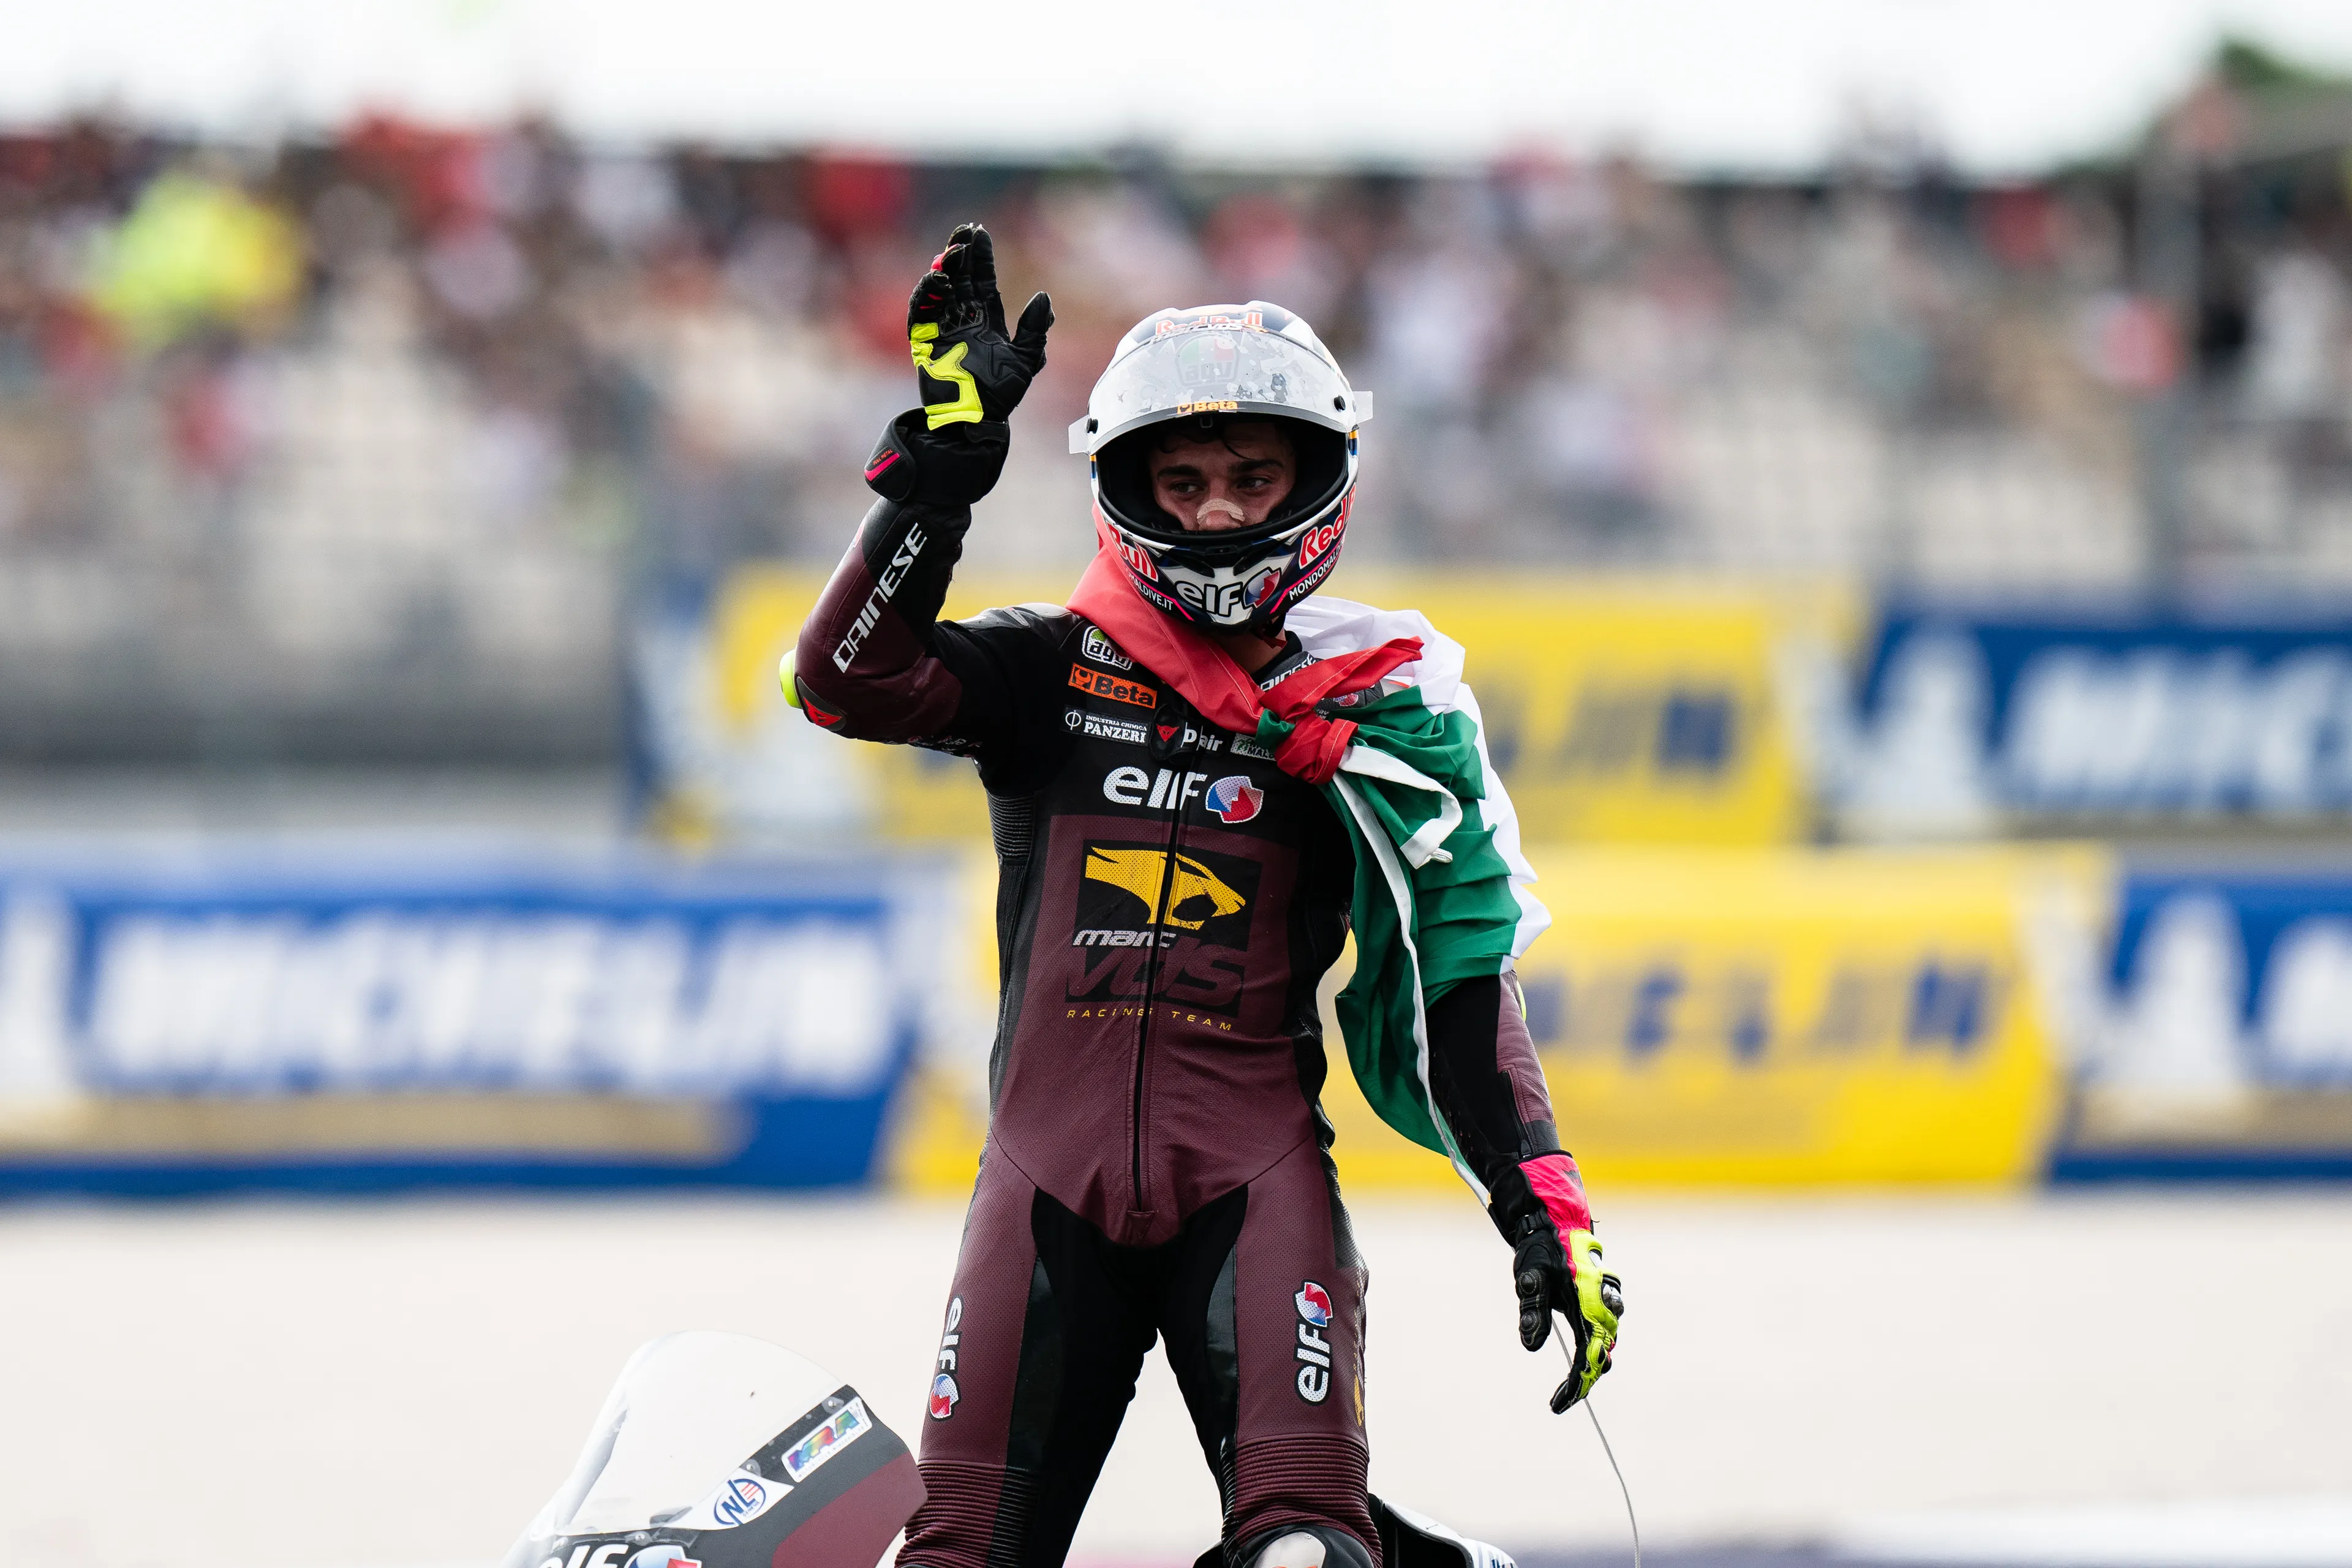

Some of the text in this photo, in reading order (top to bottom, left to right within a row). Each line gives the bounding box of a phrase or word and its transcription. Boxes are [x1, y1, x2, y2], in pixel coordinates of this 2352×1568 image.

[1194, 401, 1238, 413] Beta
[1298, 494, 1348, 570] Red
[1106, 522, 1159, 582] Bull
[832, 522, 927, 673] DAINESE
[1176, 582, 1242, 616] elf
[1093, 674, 1153, 706] Beta
[1083, 722, 1146, 743] PANZERI
[1086, 715, 1147, 731] INDUSTRIA CHIMICA
[1103, 766, 1208, 810] elf
[1072, 929, 1177, 948] marc
[1068, 935, 1244, 1007] VDS
[1066, 1008, 1232, 1031] RACING TEAM
[938, 1297, 962, 1370] elf
[1297, 1323, 1330, 1403] elf
